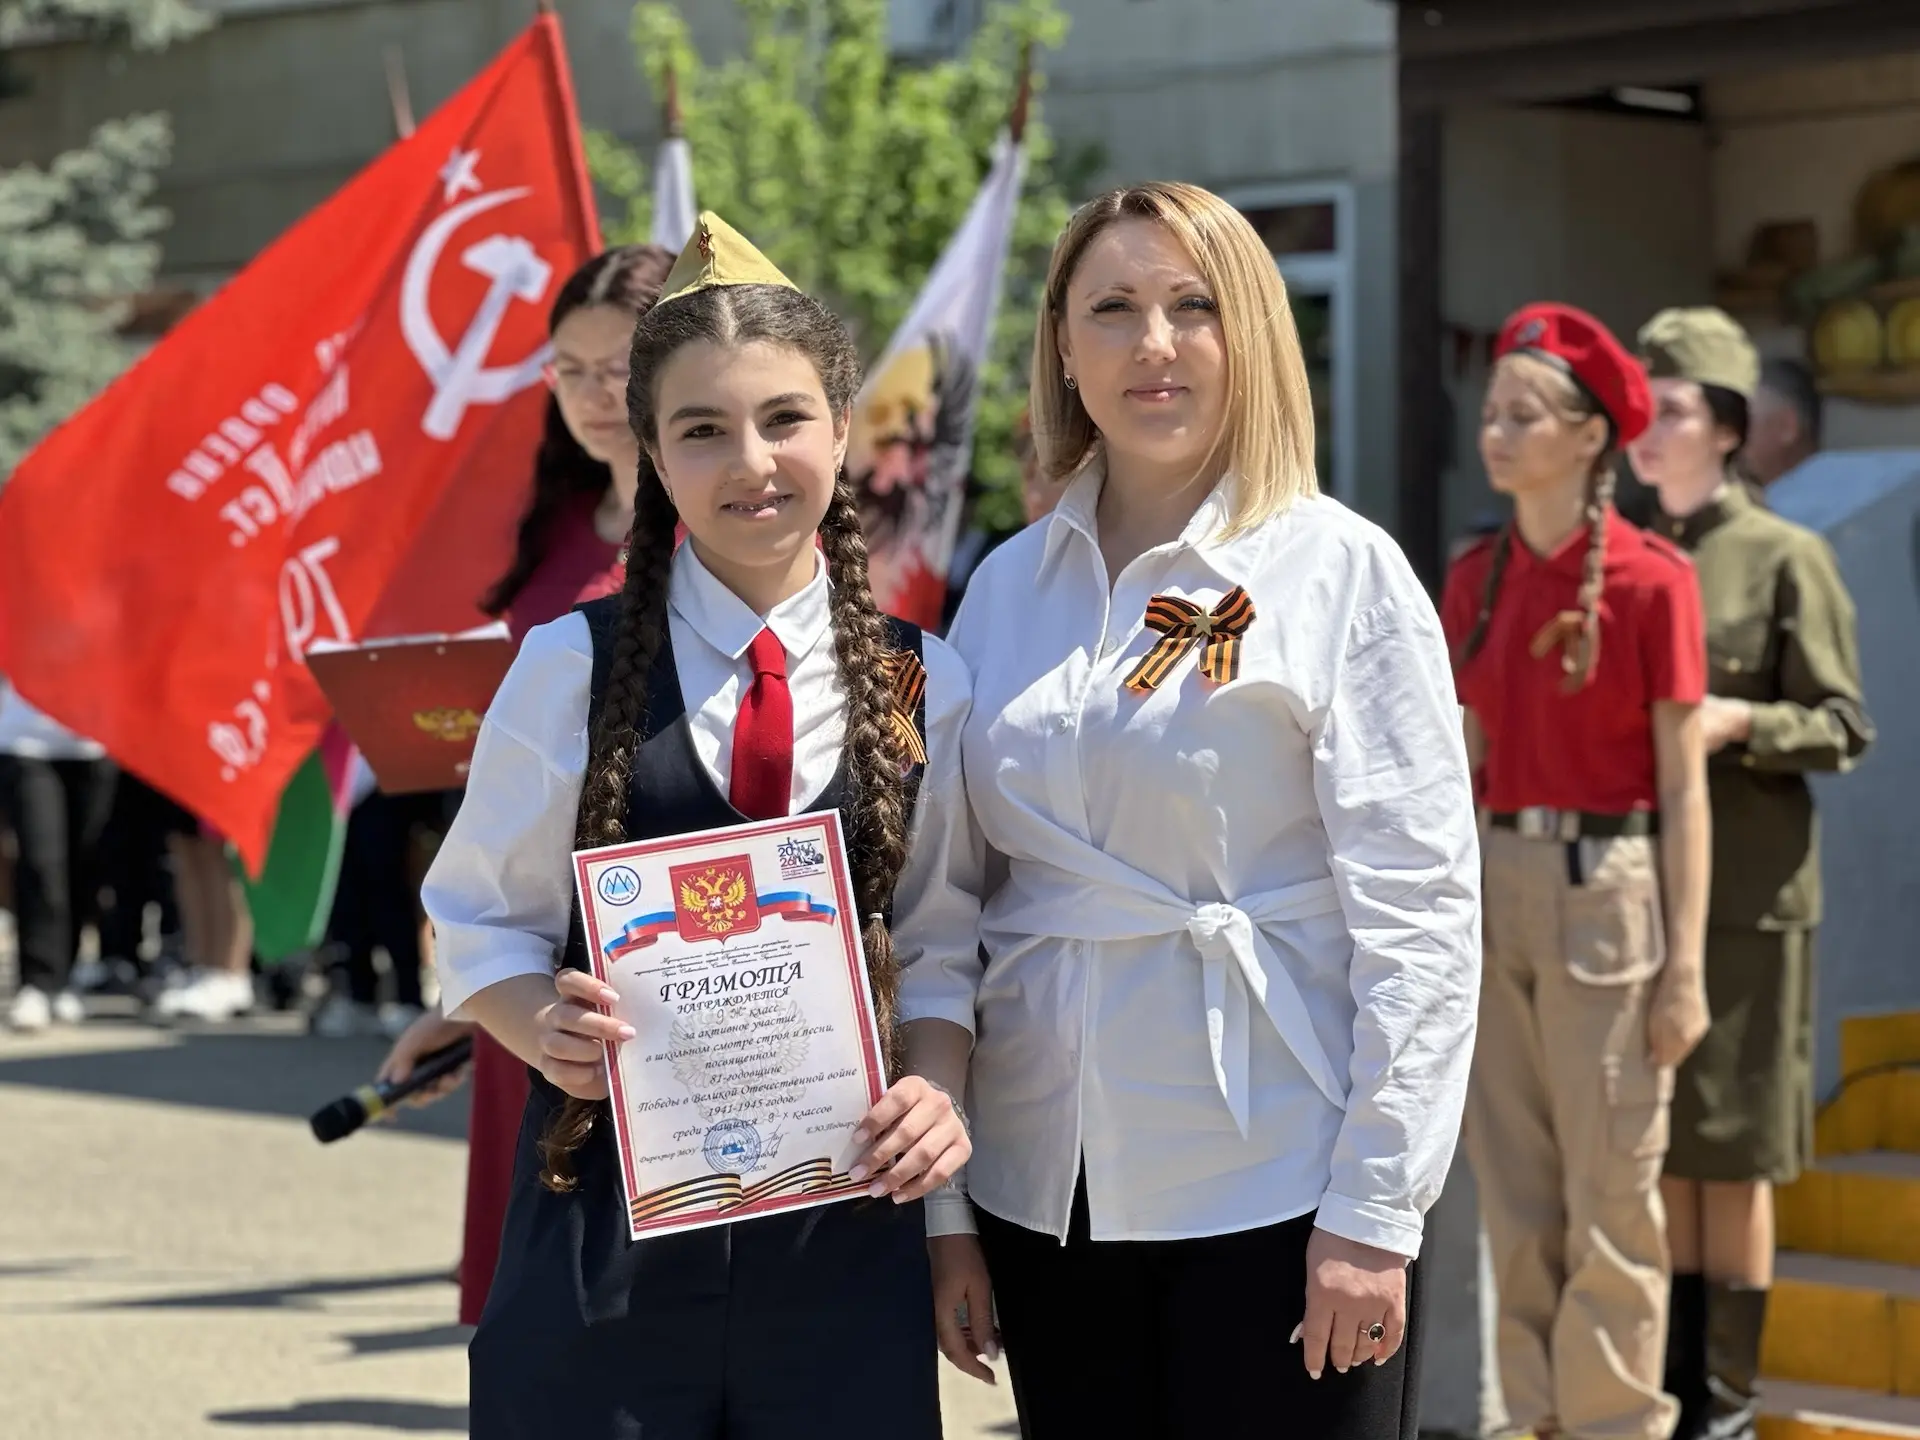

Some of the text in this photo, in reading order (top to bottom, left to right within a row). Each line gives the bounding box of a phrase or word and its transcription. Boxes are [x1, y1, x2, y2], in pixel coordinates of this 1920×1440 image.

[778, 846, 794, 857] 20
[779, 857, 795, 867] 26
[660, 960, 804, 1003] ГРАМОТА
[677, 985, 791, 1014] НАГРАЖДАЕТСЯ
[749, 1004, 779, 1018] класс
[683, 1014, 797, 1041] за активное участие
[655, 1044, 711, 1062] школьном
[713, 1037, 754, 1052] смотре
[756, 1031, 790, 1047] строя
[792, 1029, 800, 1038] и
[705, 1050, 777, 1069] посвященном
[709, 1064, 783, 1085] 81-годовщине
[637, 1066, 858, 1113] Победы в Великой Отечественной войне
[707, 1099, 763, 1117] 1941-1945
[672, 1125, 702, 1141] среди
[793, 1105, 833, 1121] классов
